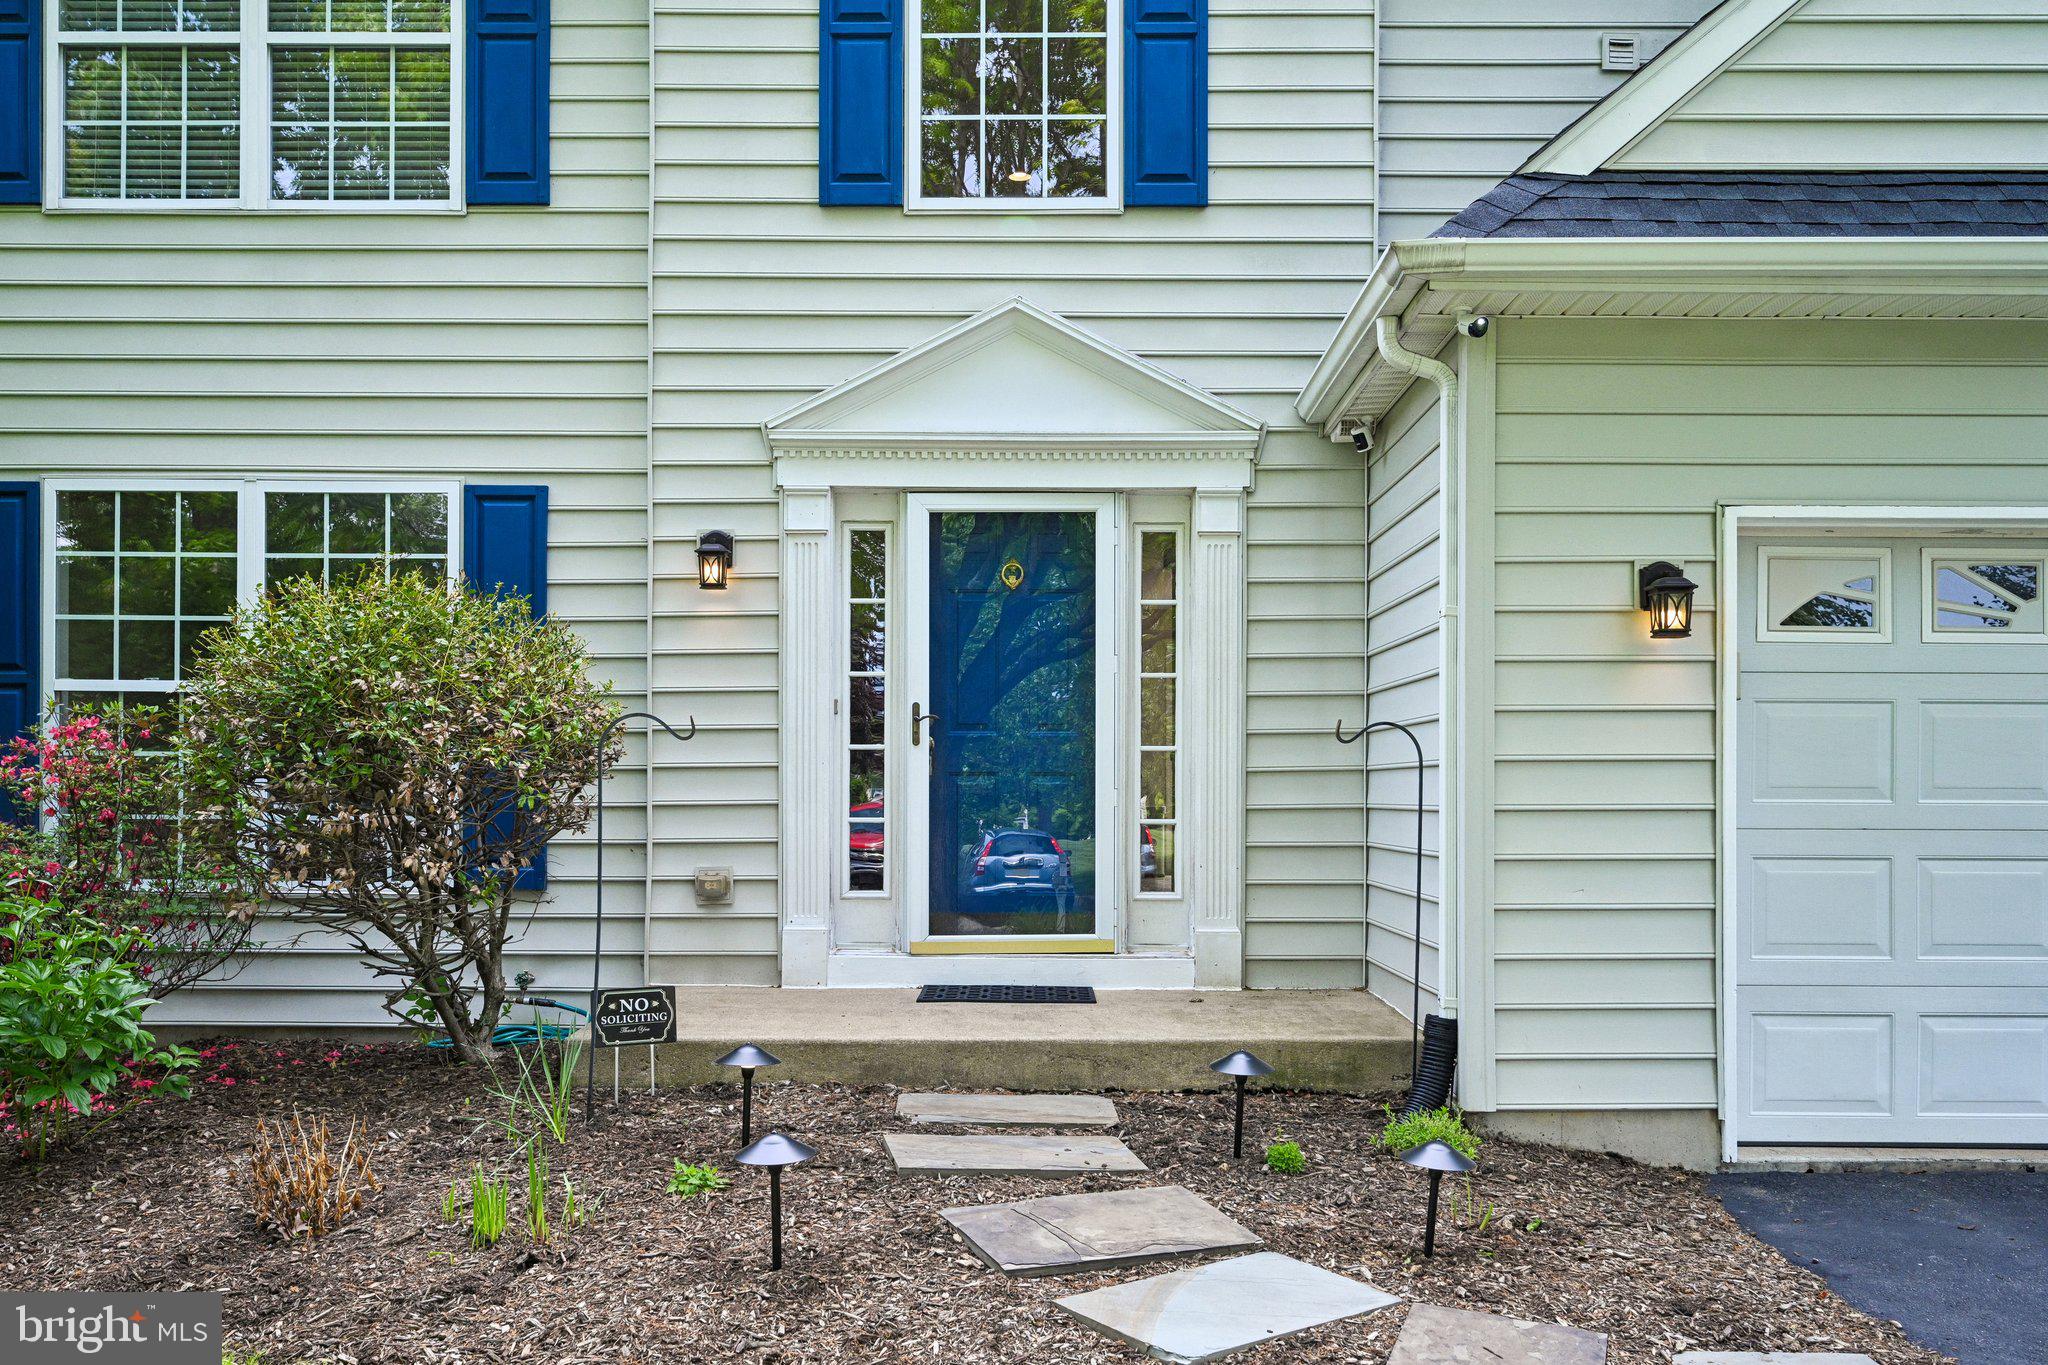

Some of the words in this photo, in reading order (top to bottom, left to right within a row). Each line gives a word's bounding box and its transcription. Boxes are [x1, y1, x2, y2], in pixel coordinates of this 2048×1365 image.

[619, 997, 649, 1013] NO
[601, 1011, 668, 1025] SOLICITING
[619, 1026, 637, 1034] Thank
